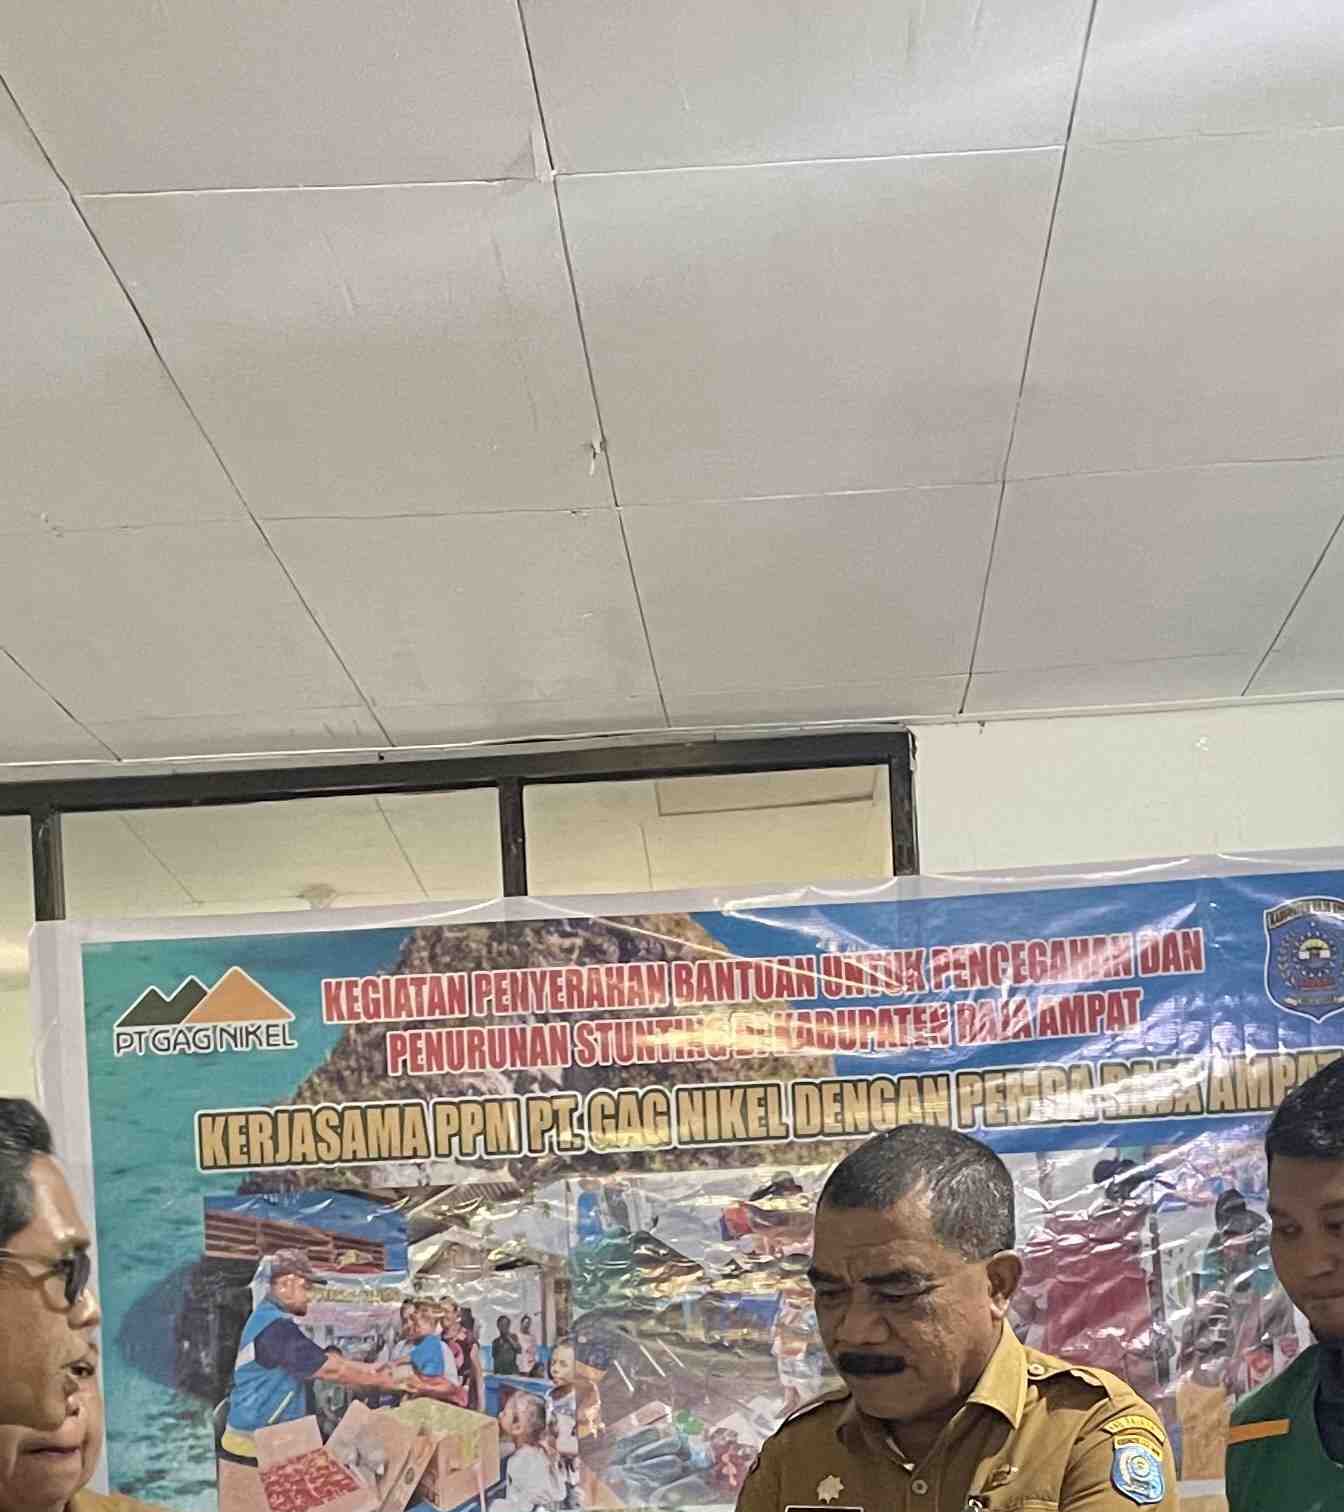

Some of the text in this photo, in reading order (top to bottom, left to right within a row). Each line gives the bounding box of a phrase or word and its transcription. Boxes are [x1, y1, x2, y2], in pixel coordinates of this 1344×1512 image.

[323, 929, 1203, 1022] KEGIATAN PENYERAHAN BANTUAN UNTUK PENCEGAHAN DAN
[116, 1024, 297, 1055] PT GAG NIKEL
[388, 1024, 570, 1074] PENURUNAN
[1038, 988, 1142, 1037] AMPAT
[198, 1102, 431, 1170] KERJASAMA
[433, 1098, 521, 1157] PPM
[527, 1094, 584, 1153] PT.
[589, 1088, 671, 1149] GAG
[675, 1083, 788, 1144] NIKEL
[793, 1074, 951, 1138] DENGAN
